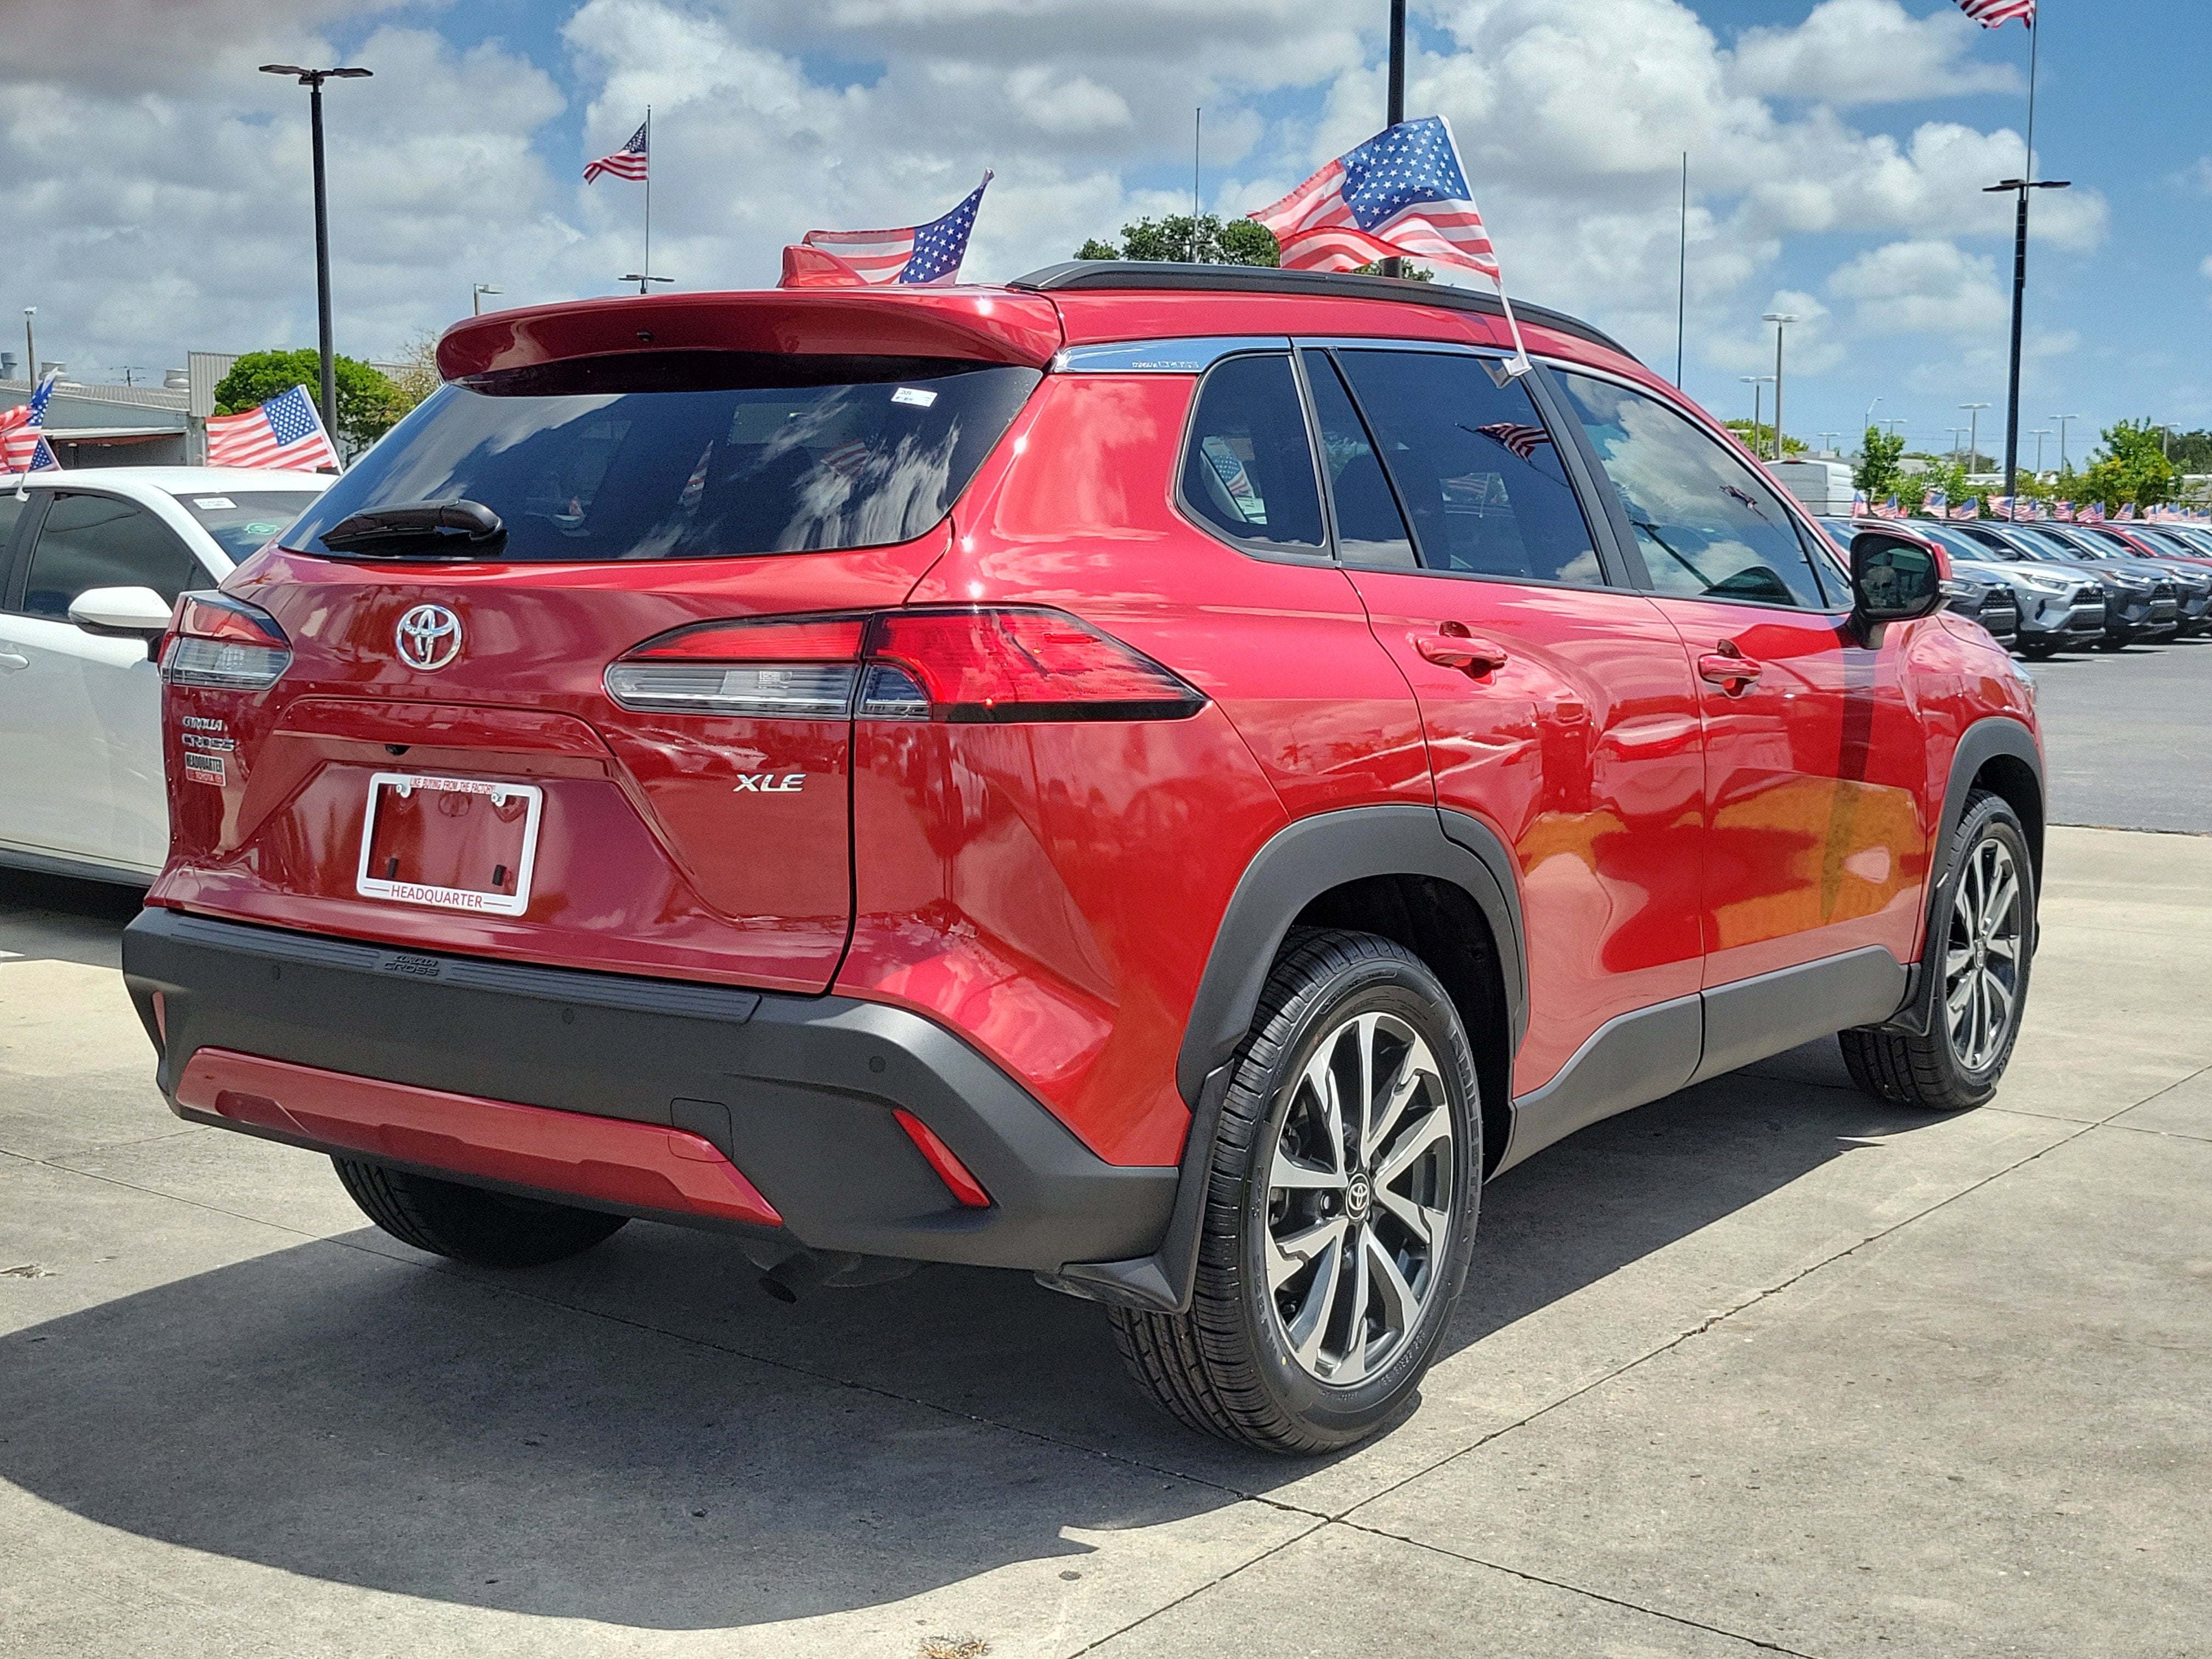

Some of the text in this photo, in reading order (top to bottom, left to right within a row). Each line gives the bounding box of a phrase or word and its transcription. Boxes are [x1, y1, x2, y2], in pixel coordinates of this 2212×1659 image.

[182, 733, 234, 751] CROSS
[444, 780, 459, 791] FROM
[460, 782, 470, 792] THE
[732, 774, 807, 792] XLE
[391, 884, 483, 908] HEADQUARTER
[385, 962, 439, 977] CROSS
